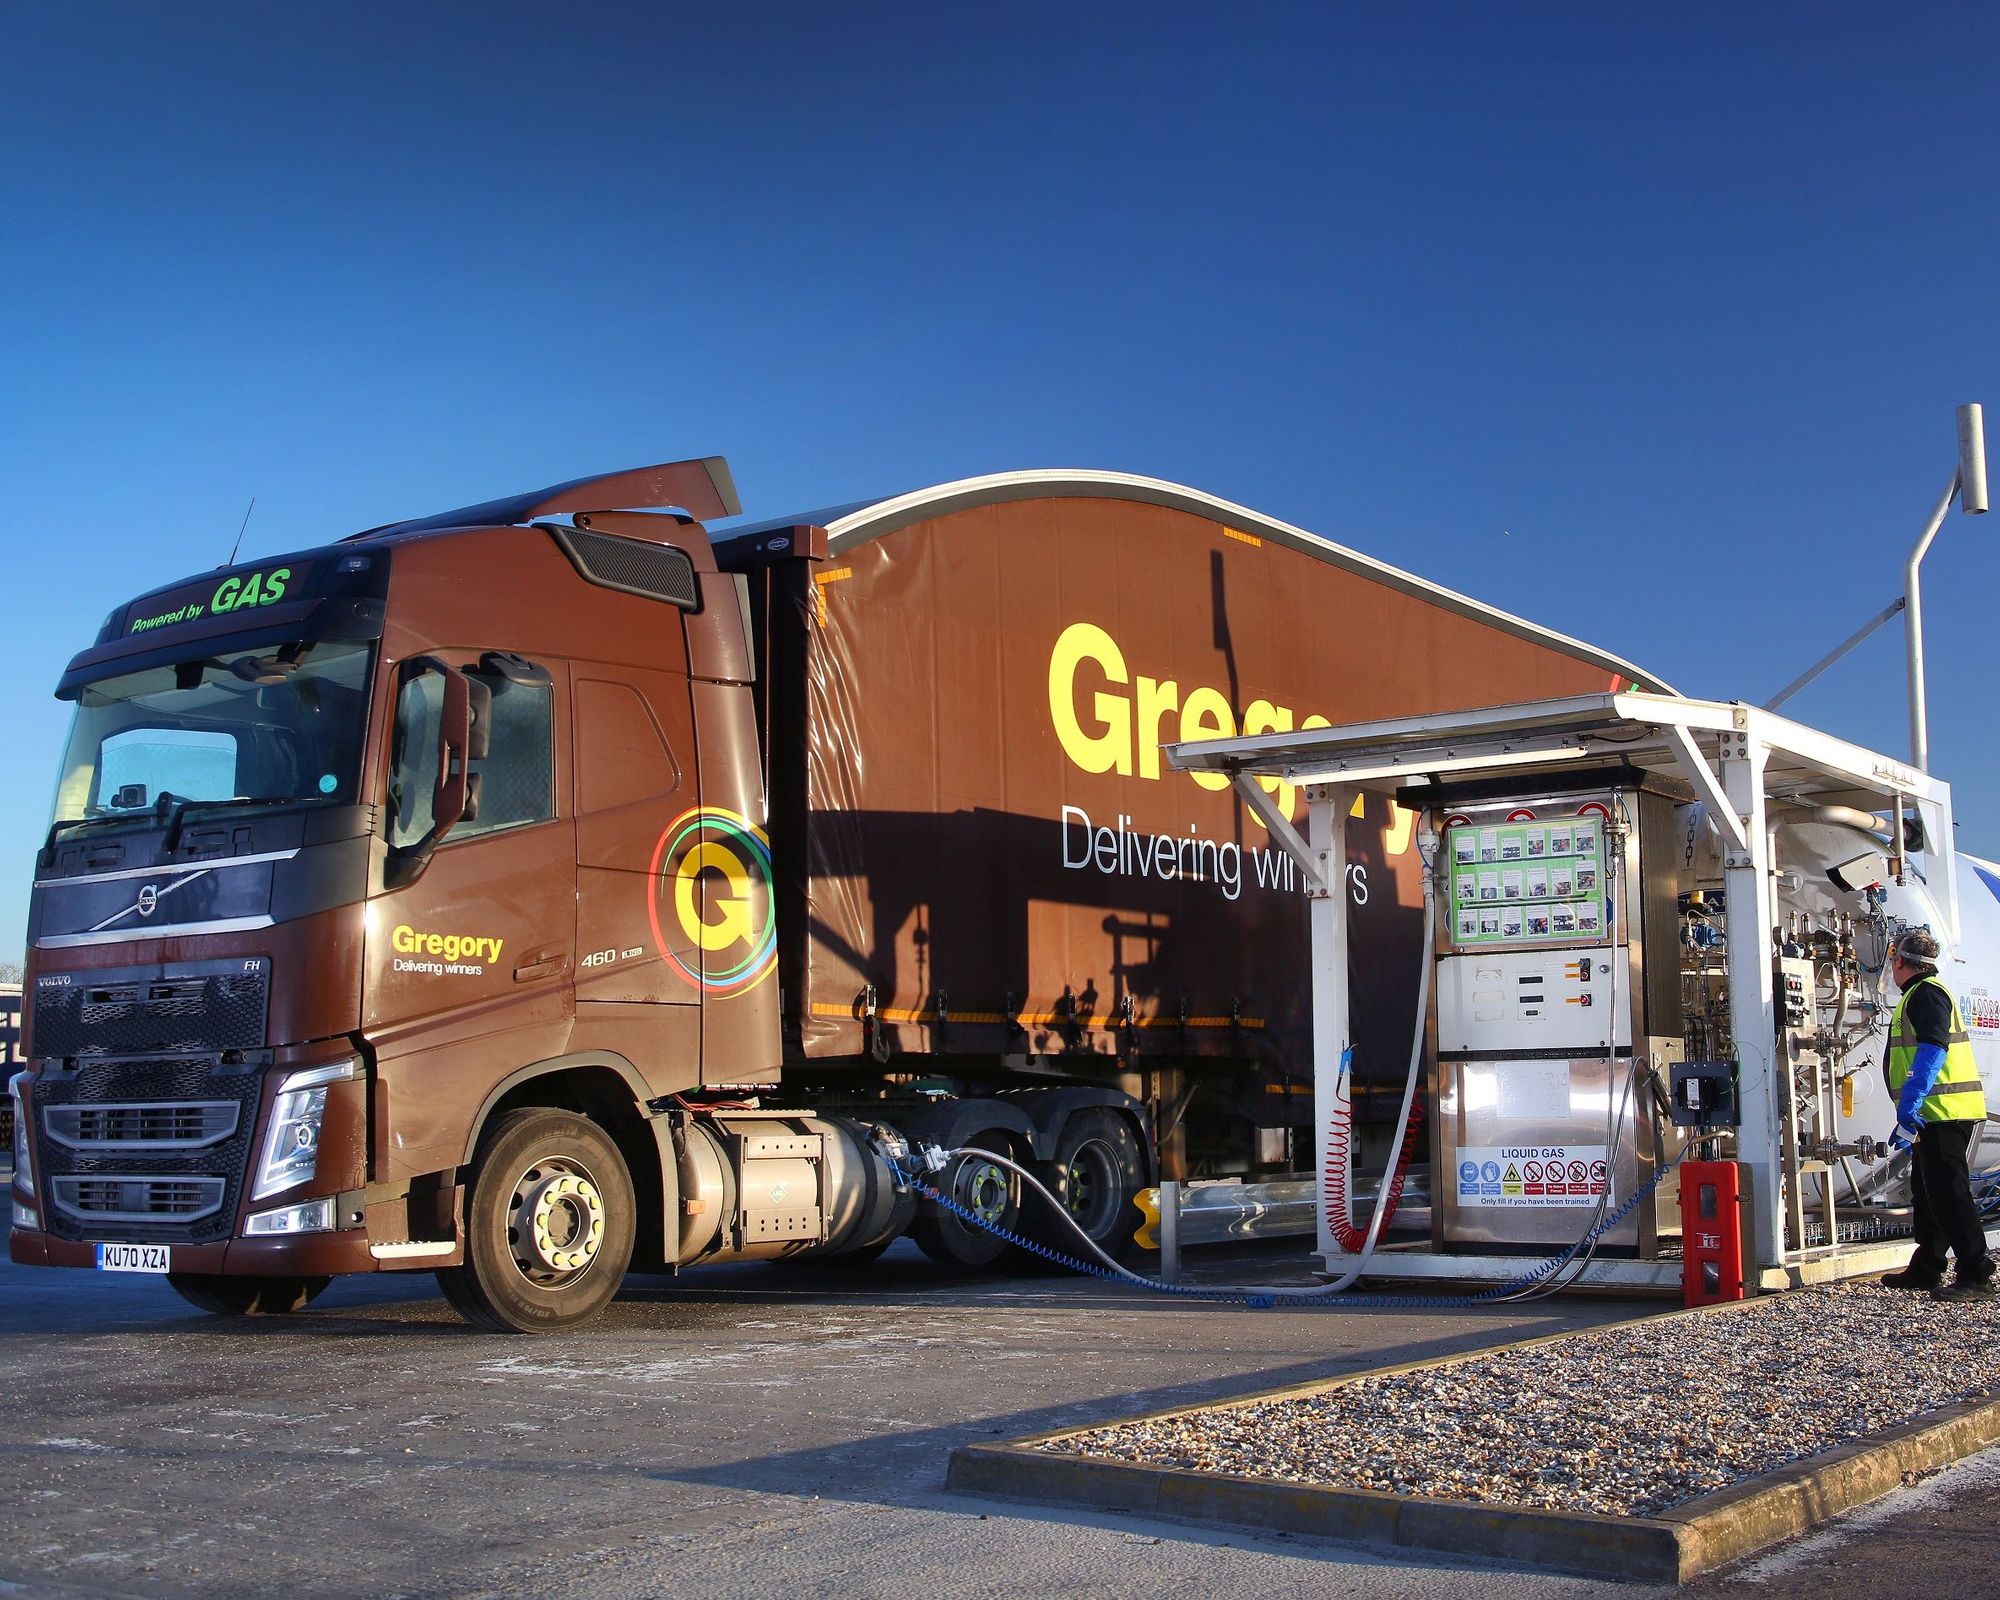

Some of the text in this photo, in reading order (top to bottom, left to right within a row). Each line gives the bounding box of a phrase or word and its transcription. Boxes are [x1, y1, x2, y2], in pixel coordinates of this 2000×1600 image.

[131, 568, 291, 634] Powered by GAS
[1049, 622, 1415, 855] Greg
[1062, 804, 1368, 905] Delivering winrs
[391, 925, 503, 964] Gregory
[244, 960, 261, 971] FH
[394, 958, 482, 976] Delivering winners
[581, 949, 616, 967] 460
[38, 975, 71, 987] VOLVO
[1501, 1148, 1565, 1159] LIQUID GAS
[1481, 1198, 1496, 1206] Only
[105, 1246, 167, 1269] KU70 XZA
